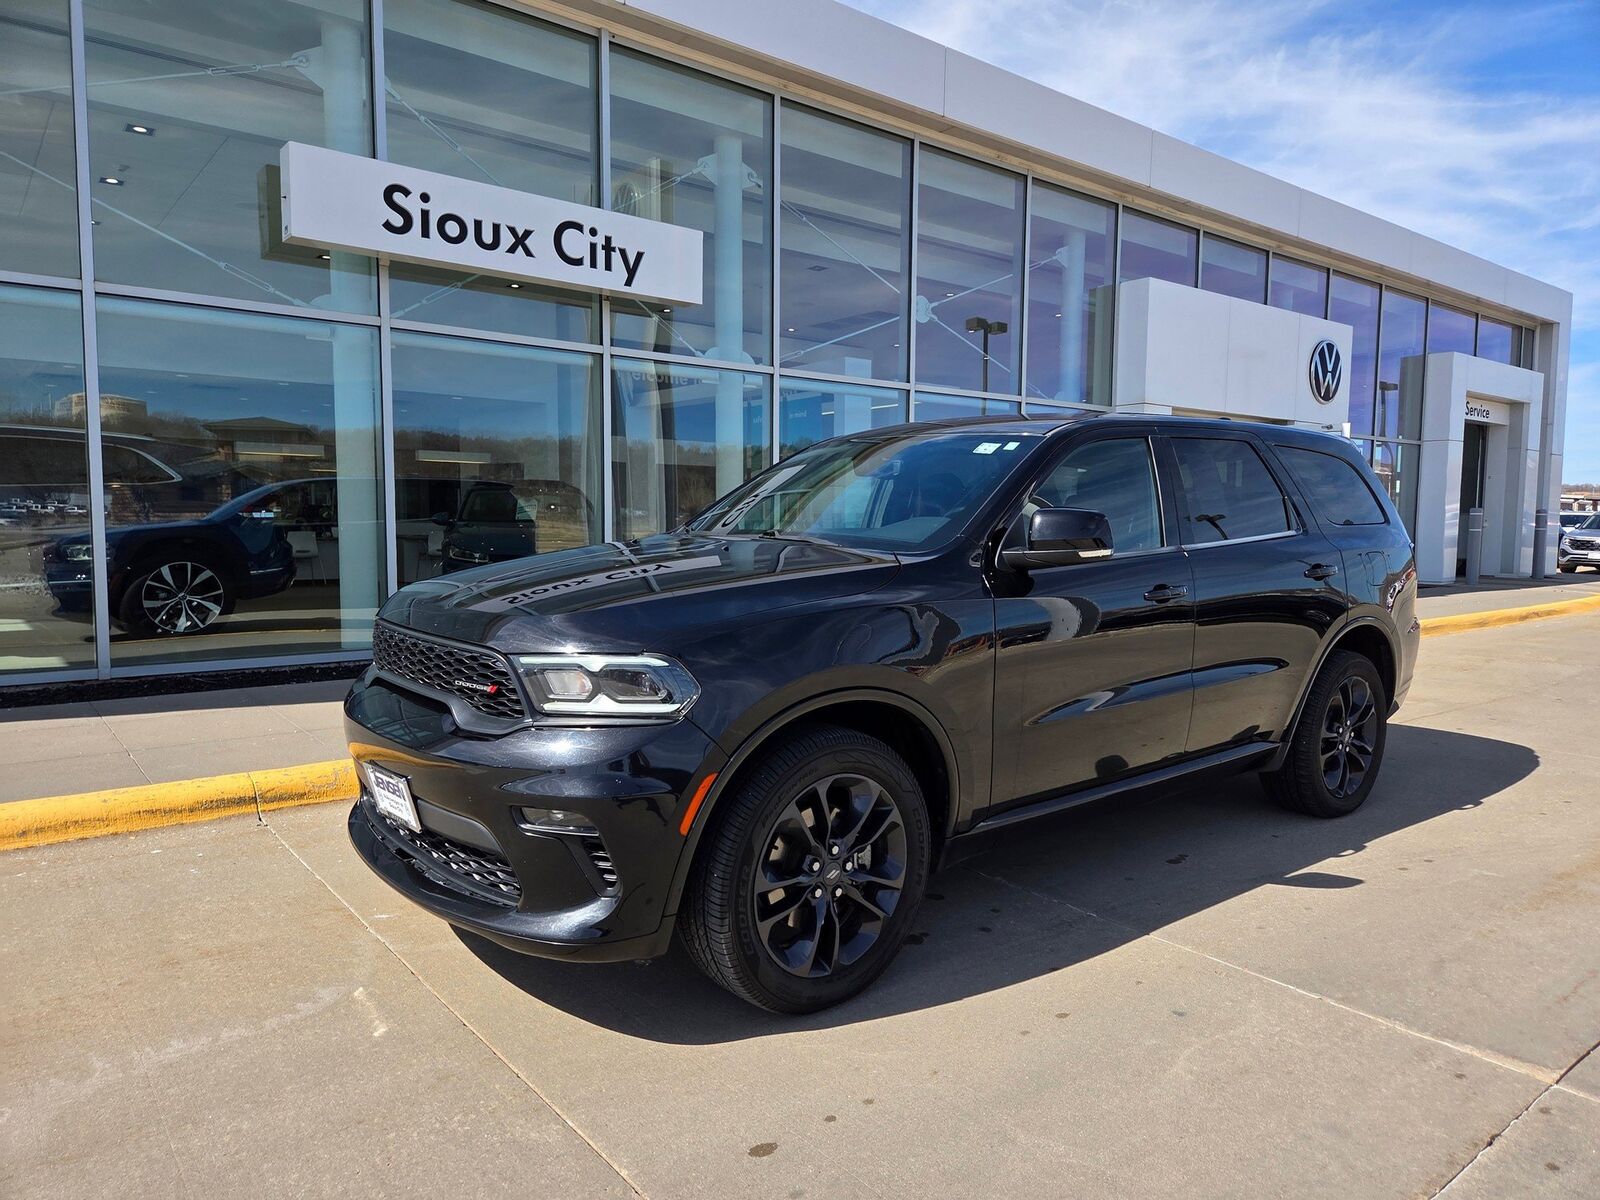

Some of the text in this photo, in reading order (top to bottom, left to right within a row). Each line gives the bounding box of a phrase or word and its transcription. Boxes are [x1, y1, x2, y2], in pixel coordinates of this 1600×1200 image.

[382, 184, 645, 287] Sioux City
[1309, 339, 1342, 405] VW
[1465, 401, 1490, 419] Service
